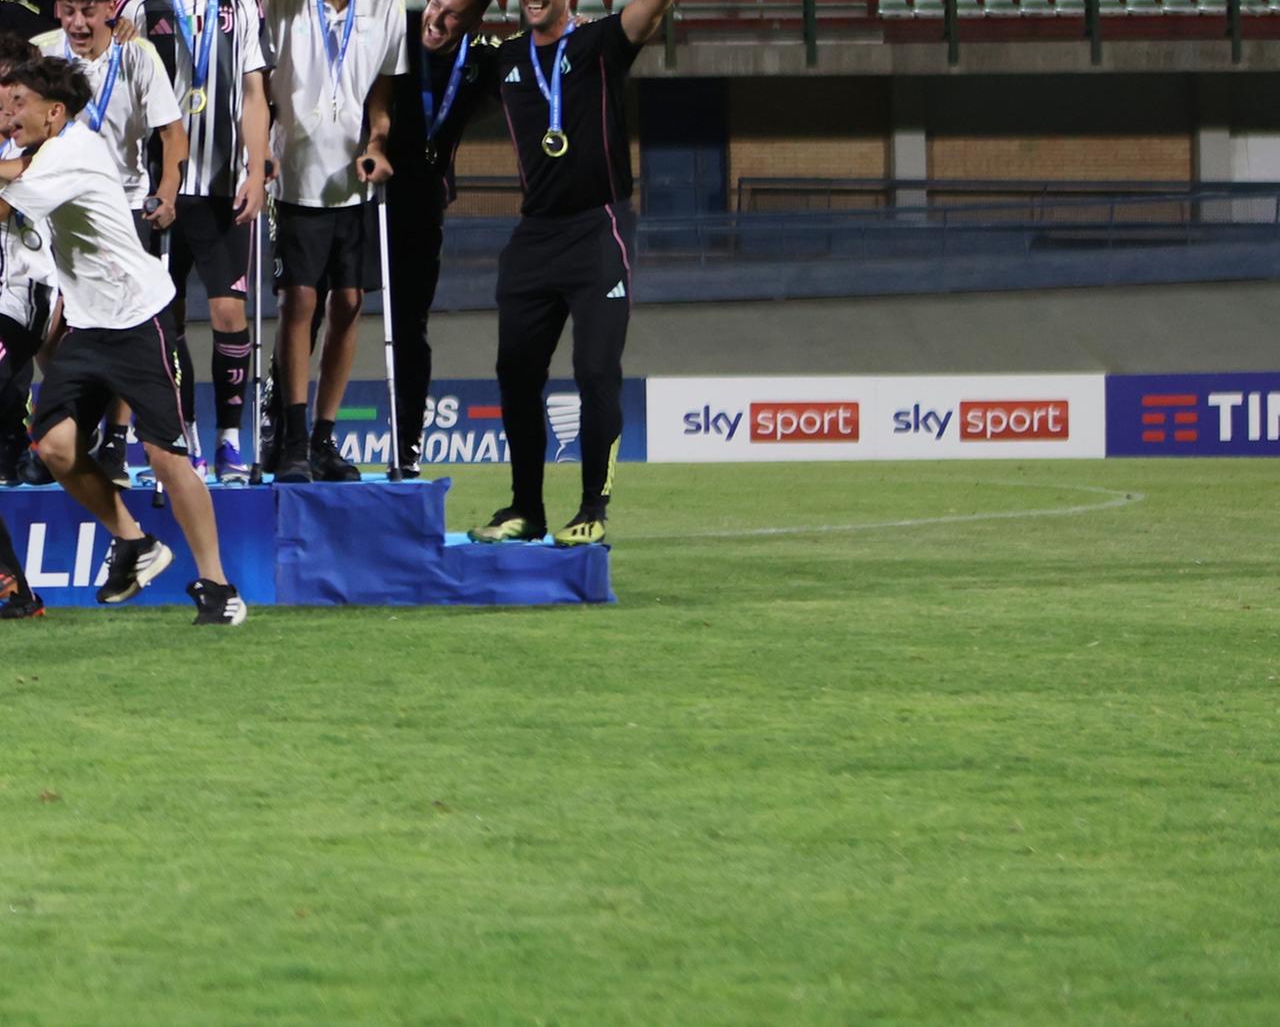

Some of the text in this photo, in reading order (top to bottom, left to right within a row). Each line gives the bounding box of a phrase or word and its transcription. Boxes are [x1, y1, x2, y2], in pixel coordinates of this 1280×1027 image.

[683, 400, 853, 441] sky sport
[893, 403, 1062, 440] sky sport
[1208, 392, 1280, 442] TI
